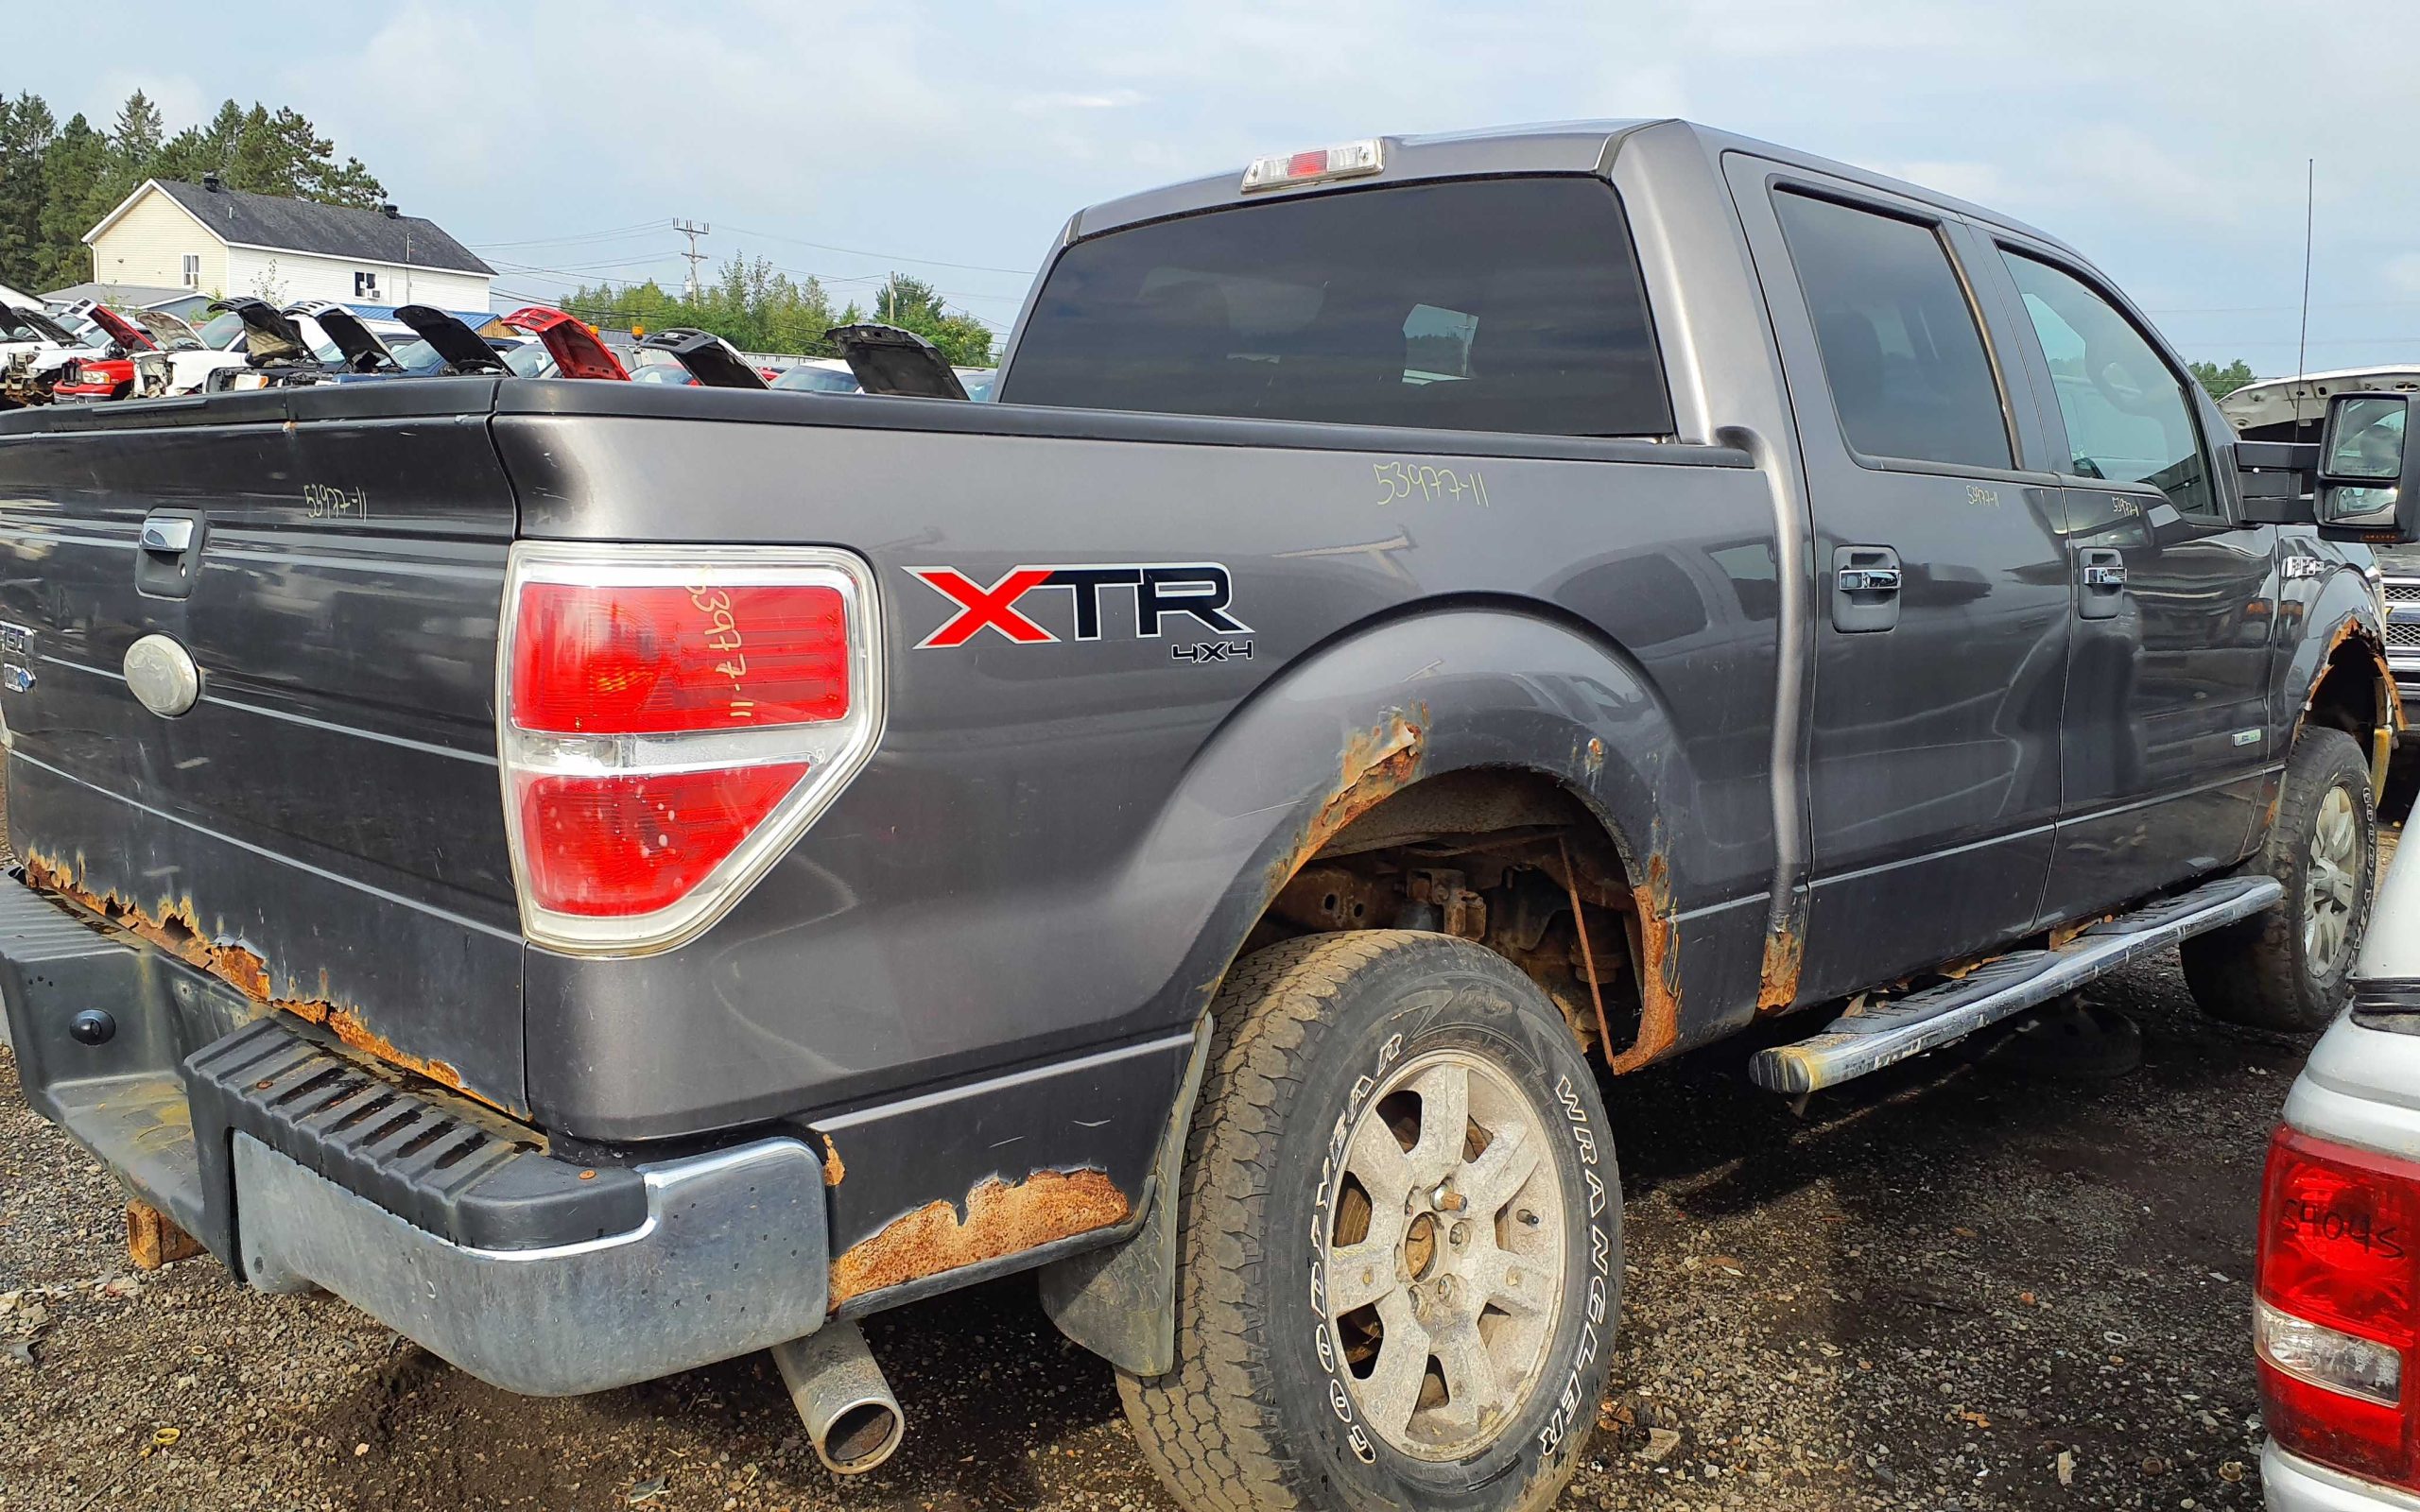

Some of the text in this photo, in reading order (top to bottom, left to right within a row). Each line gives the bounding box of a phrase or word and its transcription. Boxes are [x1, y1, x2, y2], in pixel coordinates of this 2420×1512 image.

[303, 483, 368, 524] 53977-11
[1373, 460, 1490, 508] 53977-11
[900, 561, 1256, 650] XTR
[1541, 1074, 1610, 1456] WRANGLER
